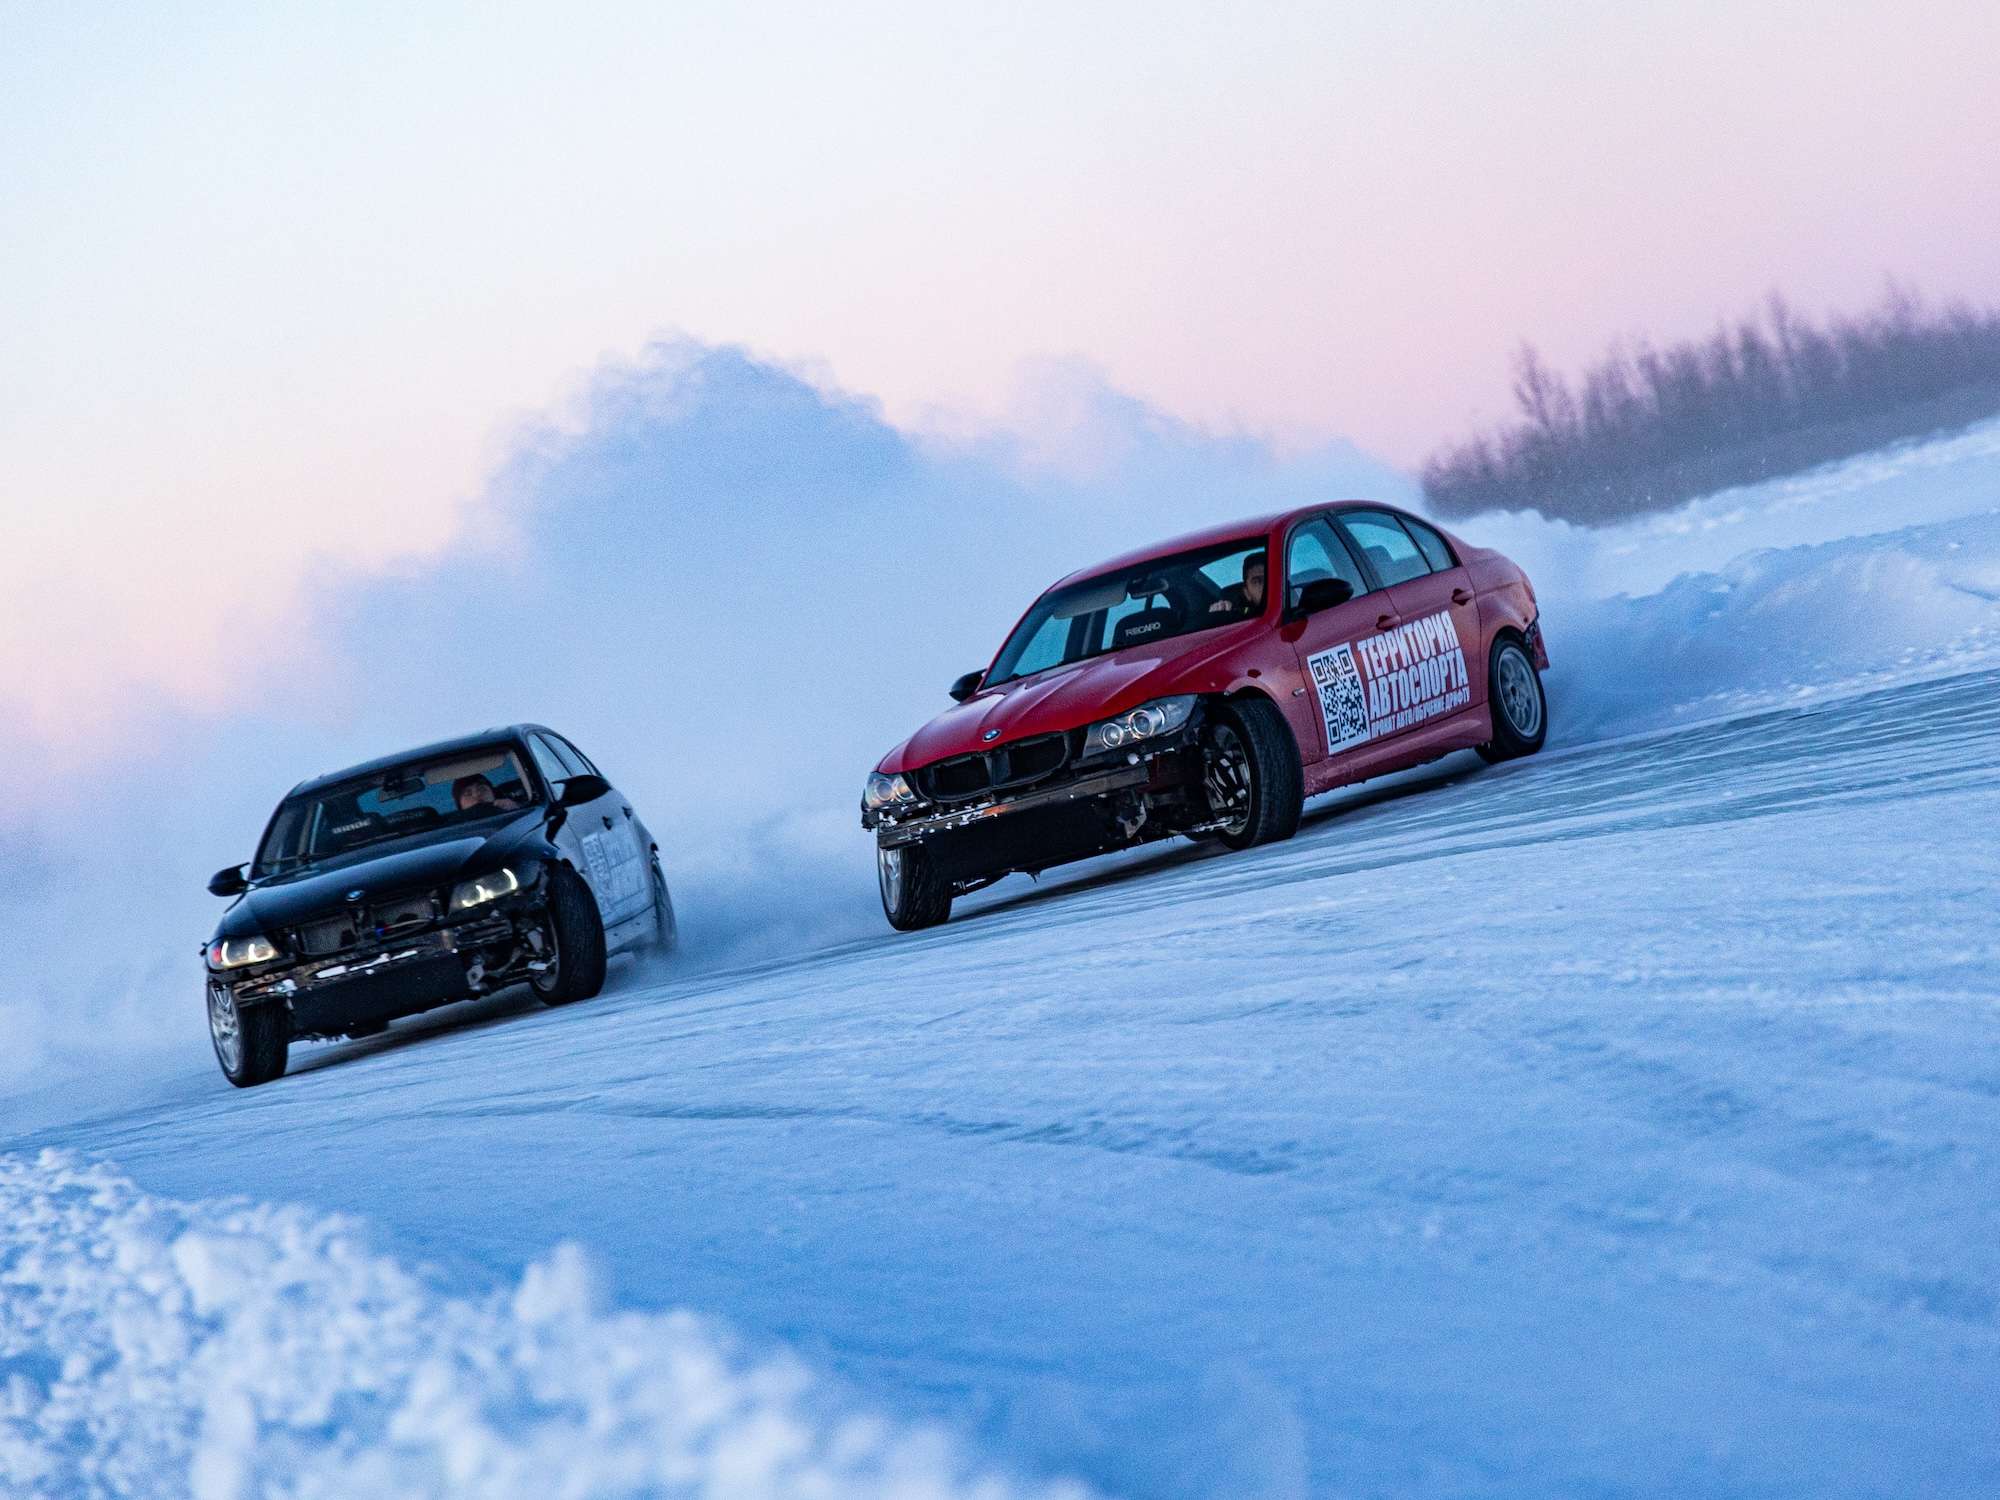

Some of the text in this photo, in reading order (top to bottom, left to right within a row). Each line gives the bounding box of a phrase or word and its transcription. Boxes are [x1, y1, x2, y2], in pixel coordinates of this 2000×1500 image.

[1125, 621, 1161, 637] RECARO
[1357, 610, 1459, 680] ТЕРРИТОРИЯ
[1368, 648, 1468, 720] АВТОСПОРТА
